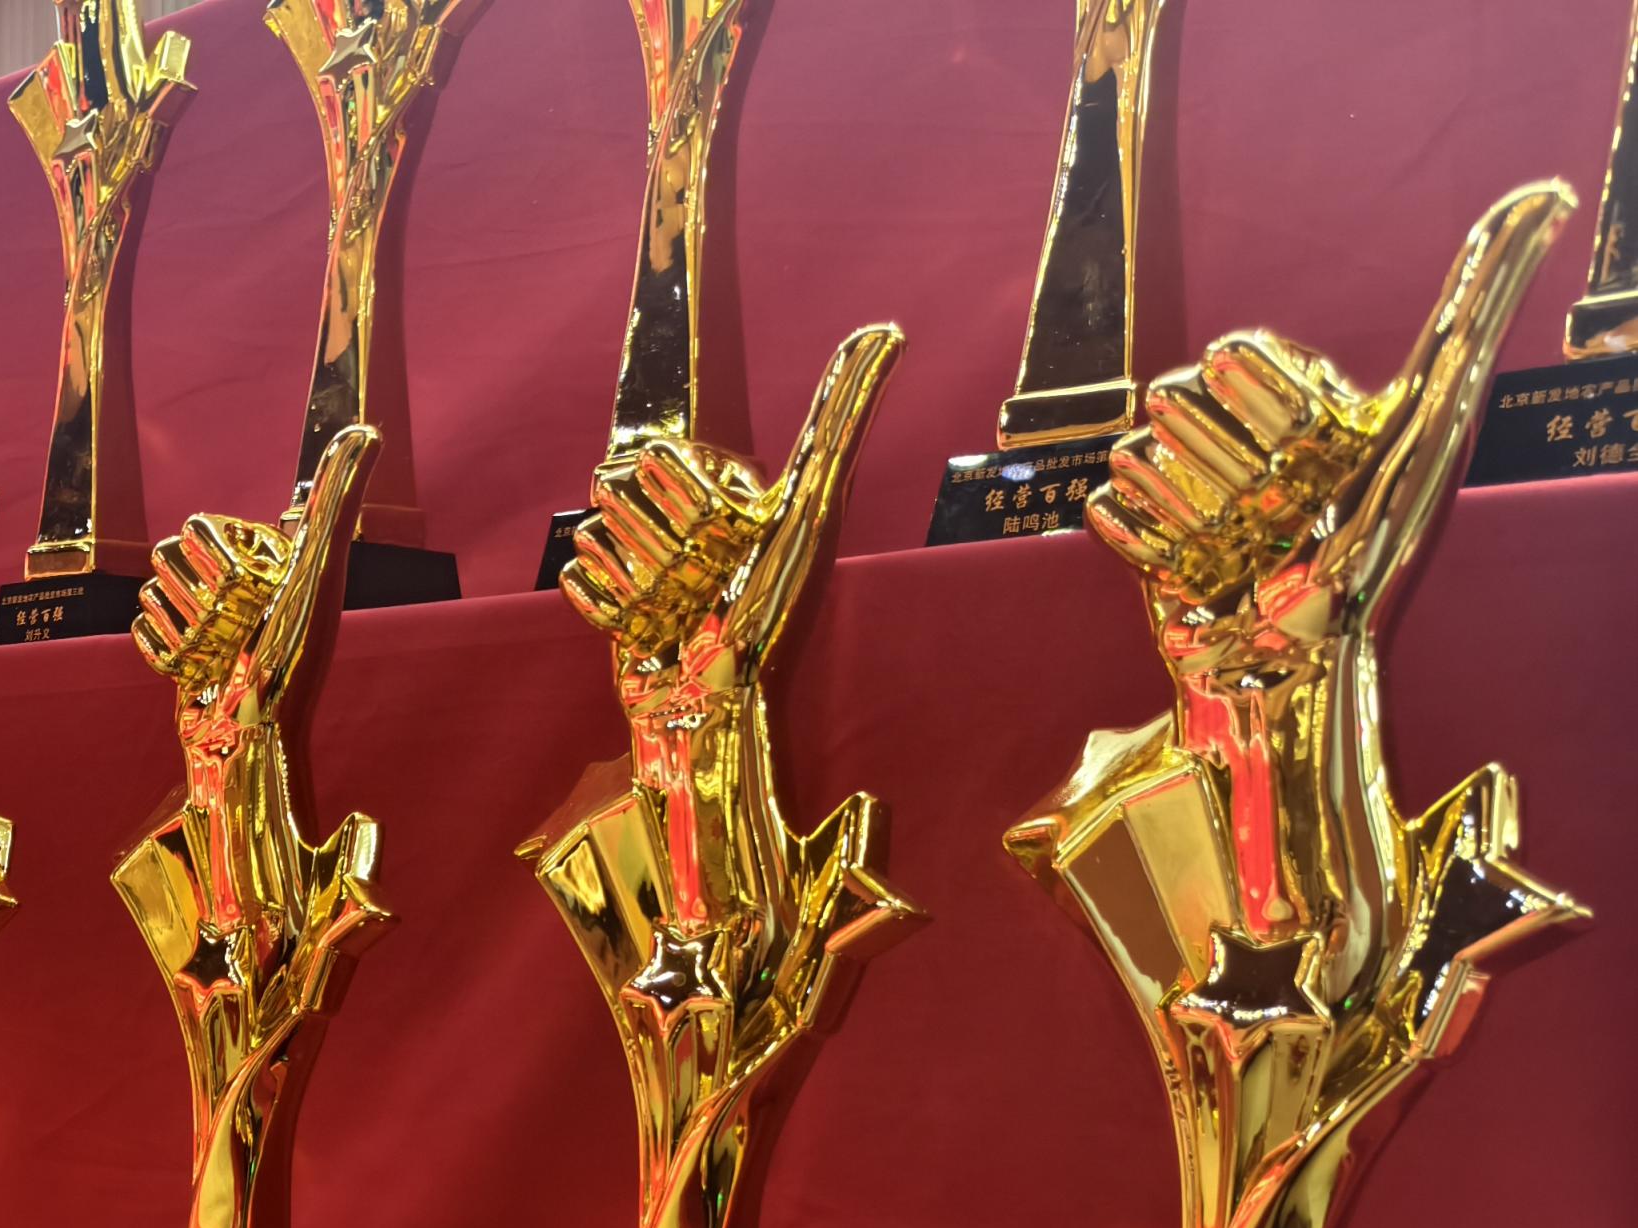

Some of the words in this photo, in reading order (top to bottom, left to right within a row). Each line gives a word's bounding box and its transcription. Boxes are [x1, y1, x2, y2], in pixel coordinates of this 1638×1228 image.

[984, 477, 1090, 512] 经营百强
[1002, 512, 1060, 534] 陆鸣池
